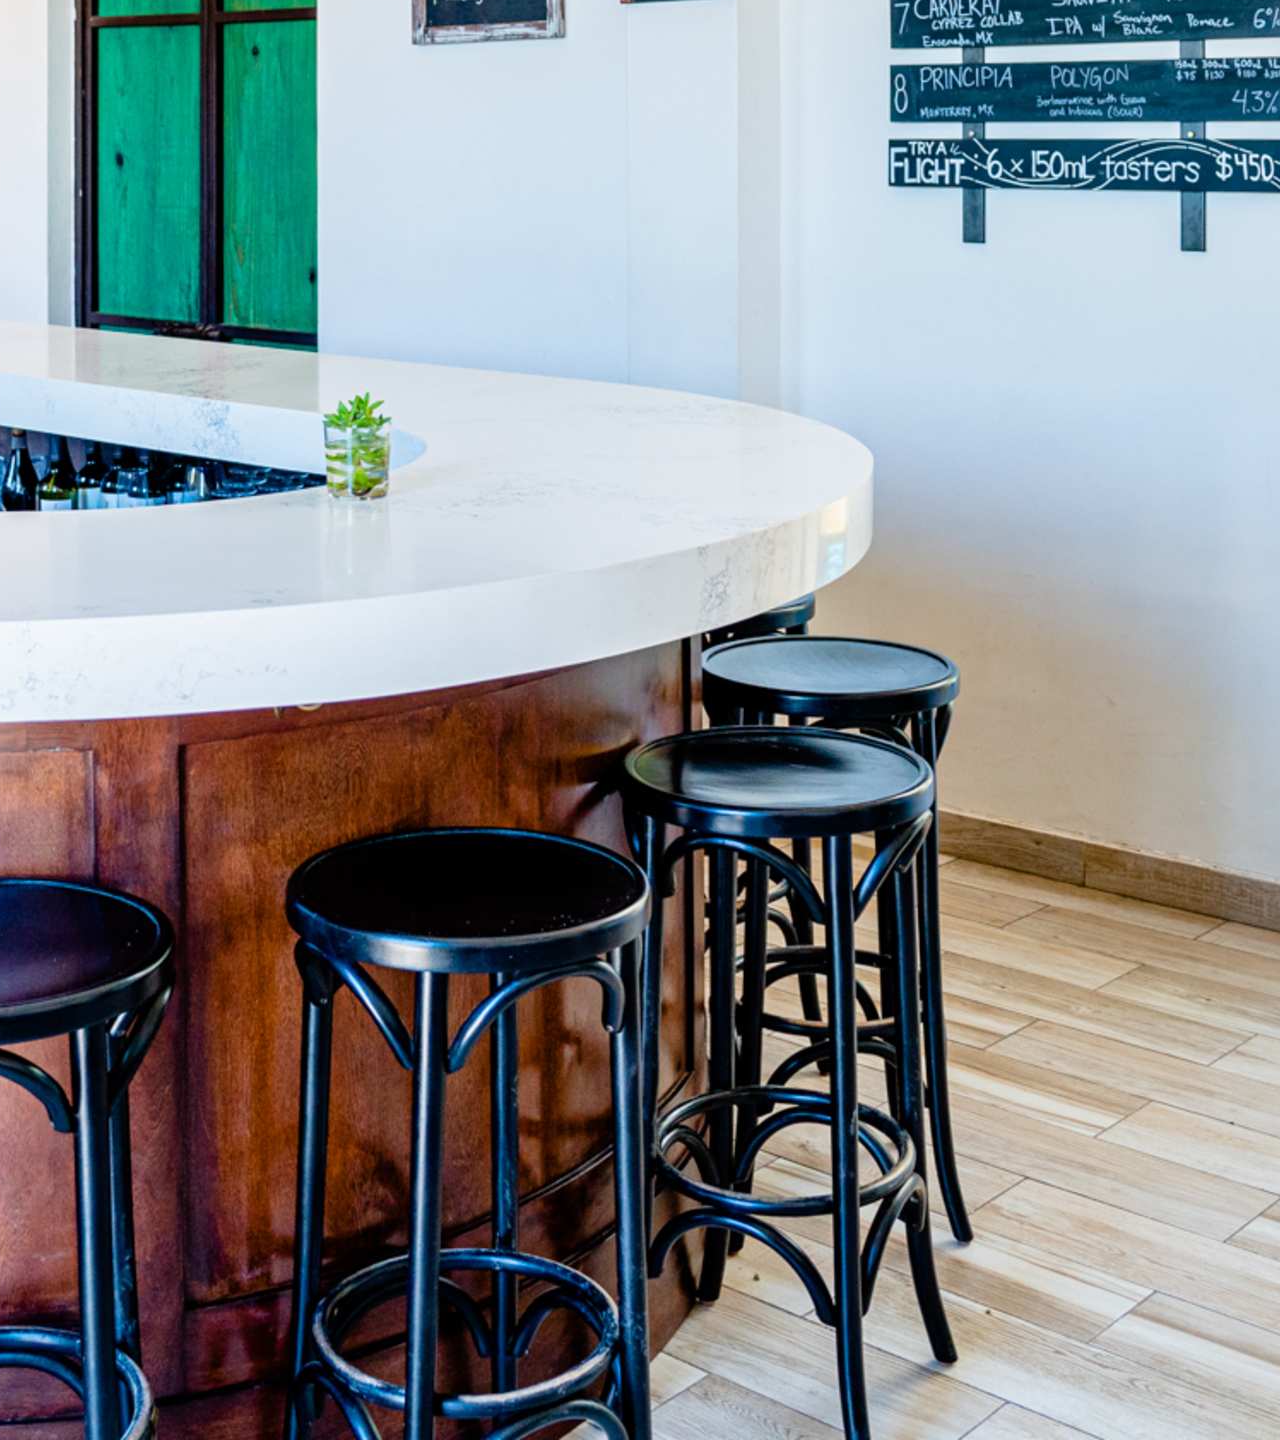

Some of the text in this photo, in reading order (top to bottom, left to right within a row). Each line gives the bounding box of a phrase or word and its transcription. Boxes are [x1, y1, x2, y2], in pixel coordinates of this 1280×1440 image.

[894, 3, 910, 35] 7
[931, 11, 1024, 30] CYPREZ COLLAB
[1046, 16, 1083, 36] IPA
[1186, 13, 1235, 28] Pomace
[1123, 23, 1163, 36] Blanc
[920, 66, 1013, 91] PRINCIPIA
[1050, 64, 1129, 92] POLYGON
[894, 73, 909, 114] 8
[1232, 89, 1280, 115] 4.3%
[908, 142, 948, 156] TRY A
[987, 149, 1002, 179] 6
[1032, 150, 1096, 180] 150mL
[1100, 155, 1200, 183] tasters
[1215, 151, 1274, 182] $450
